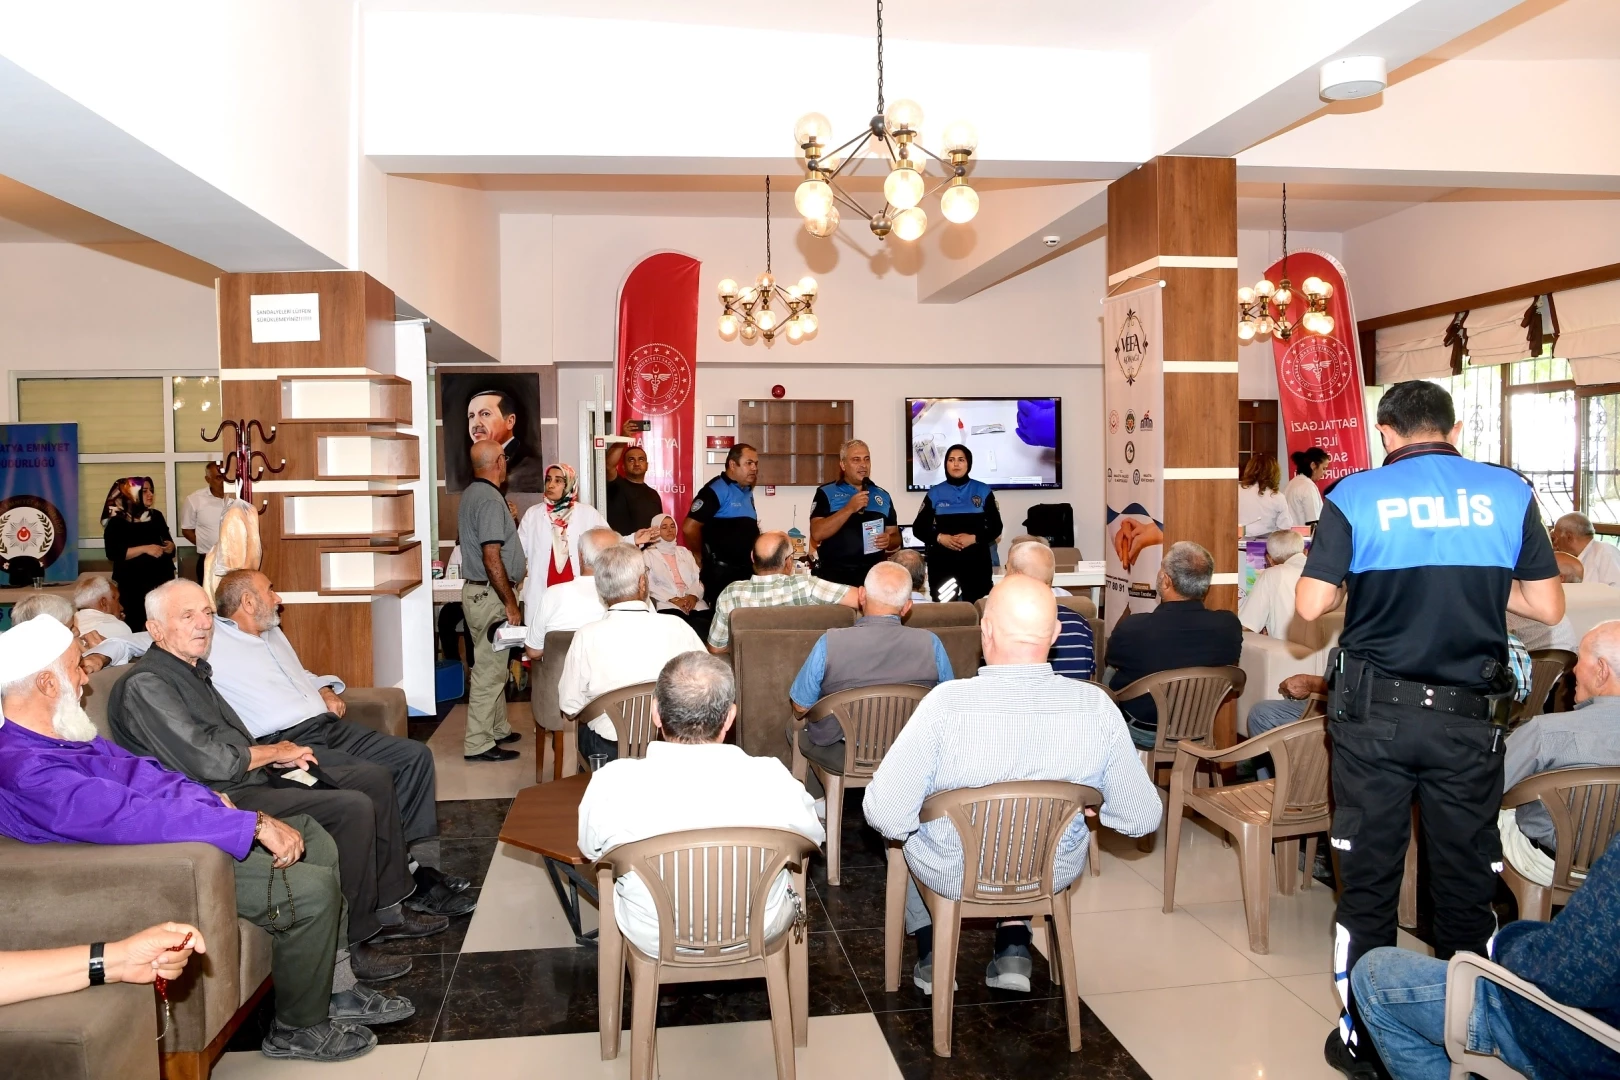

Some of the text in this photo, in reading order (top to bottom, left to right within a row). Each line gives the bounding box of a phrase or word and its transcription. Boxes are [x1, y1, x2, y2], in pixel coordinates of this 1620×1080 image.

[0, 441, 70, 453] ATYA EMNİYET
[0, 456, 55, 469] ÜDÜRLÜĞÜ
[1376, 488, 1494, 532] POLİS
